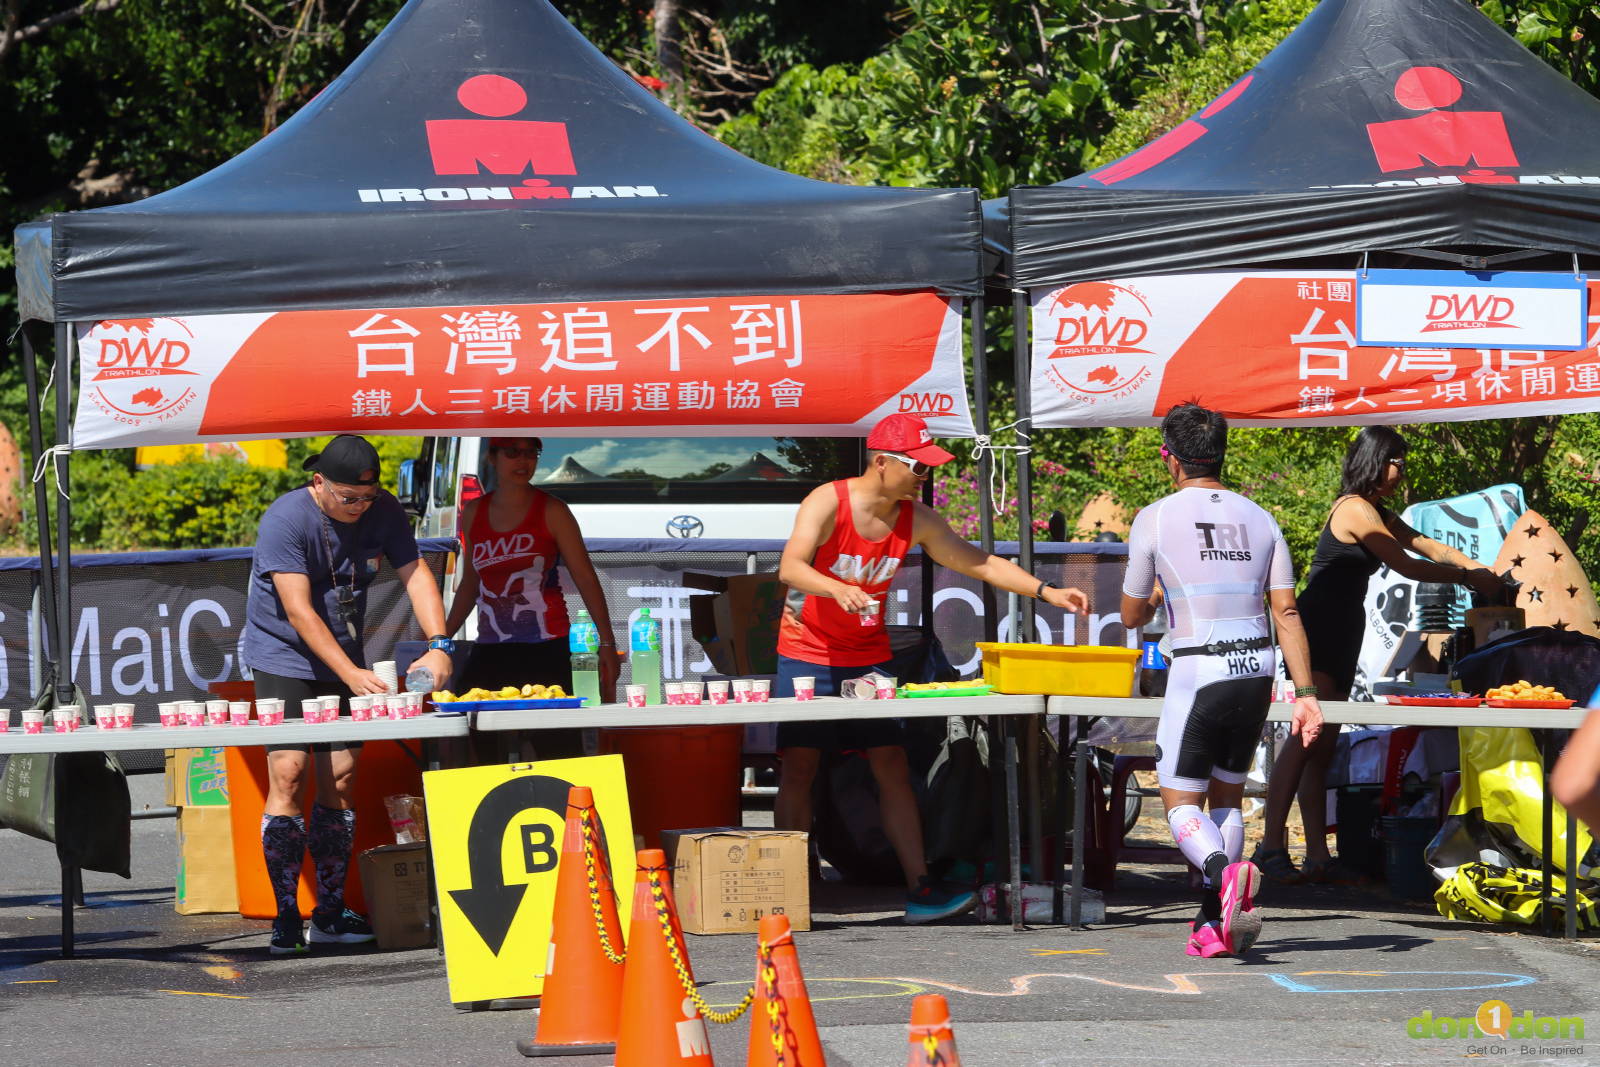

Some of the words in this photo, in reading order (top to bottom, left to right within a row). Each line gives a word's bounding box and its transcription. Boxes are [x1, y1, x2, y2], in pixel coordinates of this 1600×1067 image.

[1127, 284, 1148, 300] Run
[1425, 294, 1515, 322] DWD
[347, 298, 804, 379] 台灣追不到
[1053, 316, 1148, 346] DWD
[1431, 321, 1487, 329] TRIATHLON
[96, 337, 191, 368] DWD
[1058, 347, 1117, 355] TRIATHLON
[103, 368, 161, 377] TRIATHLON
[350, 378, 806, 419] 鐵人三項休閒運動協會
[1044, 370, 1066, 393] since
[1069, 391, 1097, 405] 2008
[1112, 369, 1152, 401] TAIWAN
[88, 392, 111, 415] since
[114, 413, 142, 426] 2008
[157, 391, 198, 423] TAIWAN
[897, 392, 954, 412] DWD
[472, 533, 535, 563] DWD
[475, 554, 516, 568] TRIATHLON
[1199, 550, 1252, 562] FITNESS
[829, 553, 901, 587] DWD
[1147, 645, 1155, 666] PEPSI
[1227, 656, 1260, 675] HKG
[519, 823, 559, 874] B
